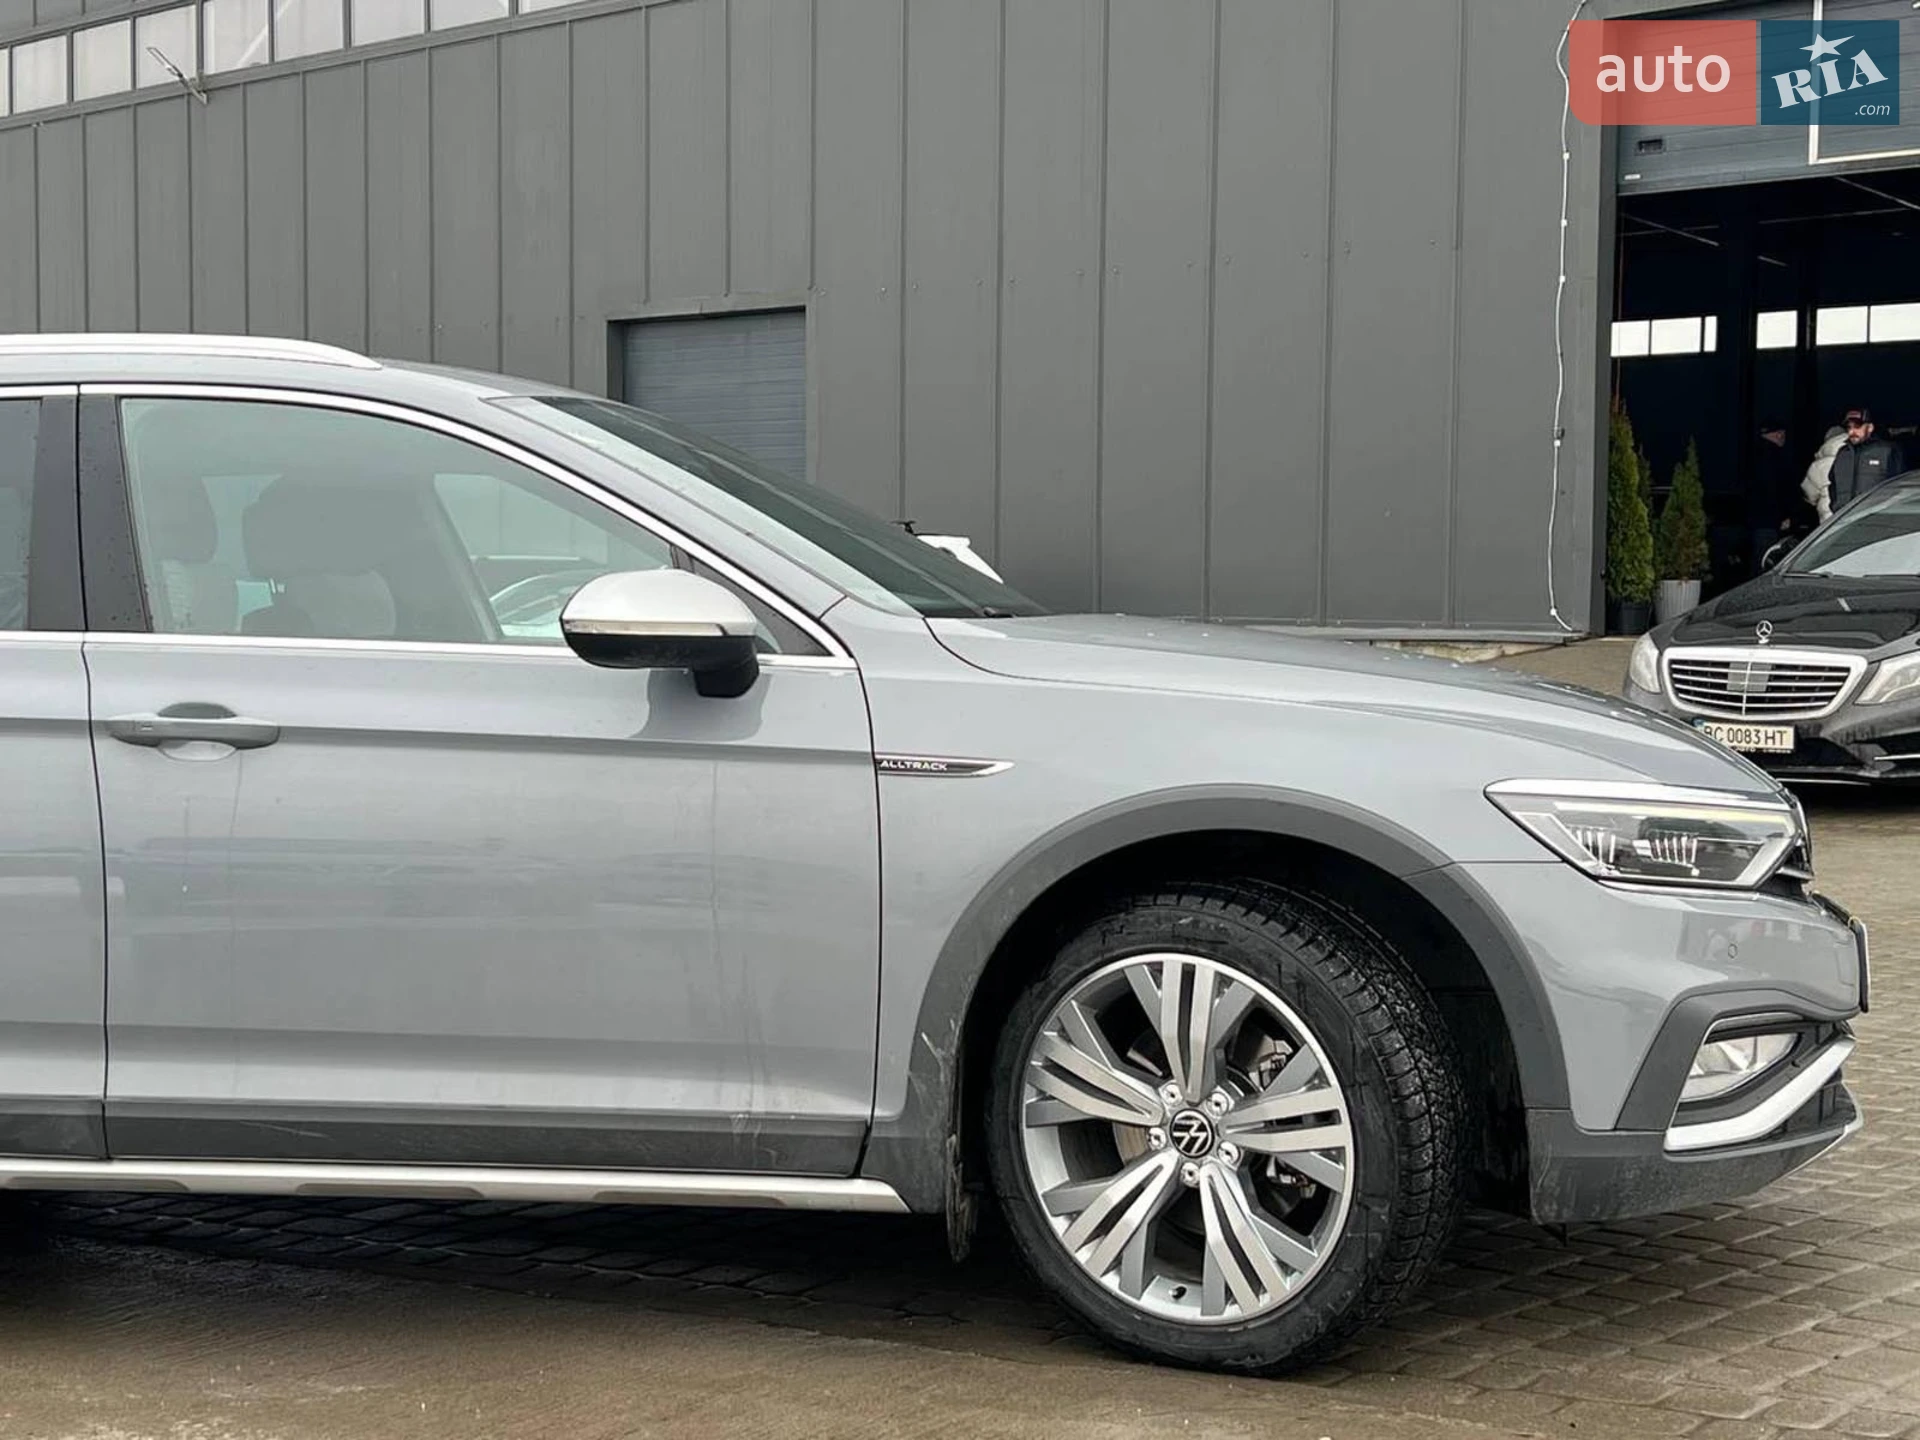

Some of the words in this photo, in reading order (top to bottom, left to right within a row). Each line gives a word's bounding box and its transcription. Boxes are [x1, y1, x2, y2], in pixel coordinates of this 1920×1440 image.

[1727, 727, 1760, 745] 0083
[1765, 730, 1787, 746] HT
[880, 760, 948, 771] ALLTRACK
